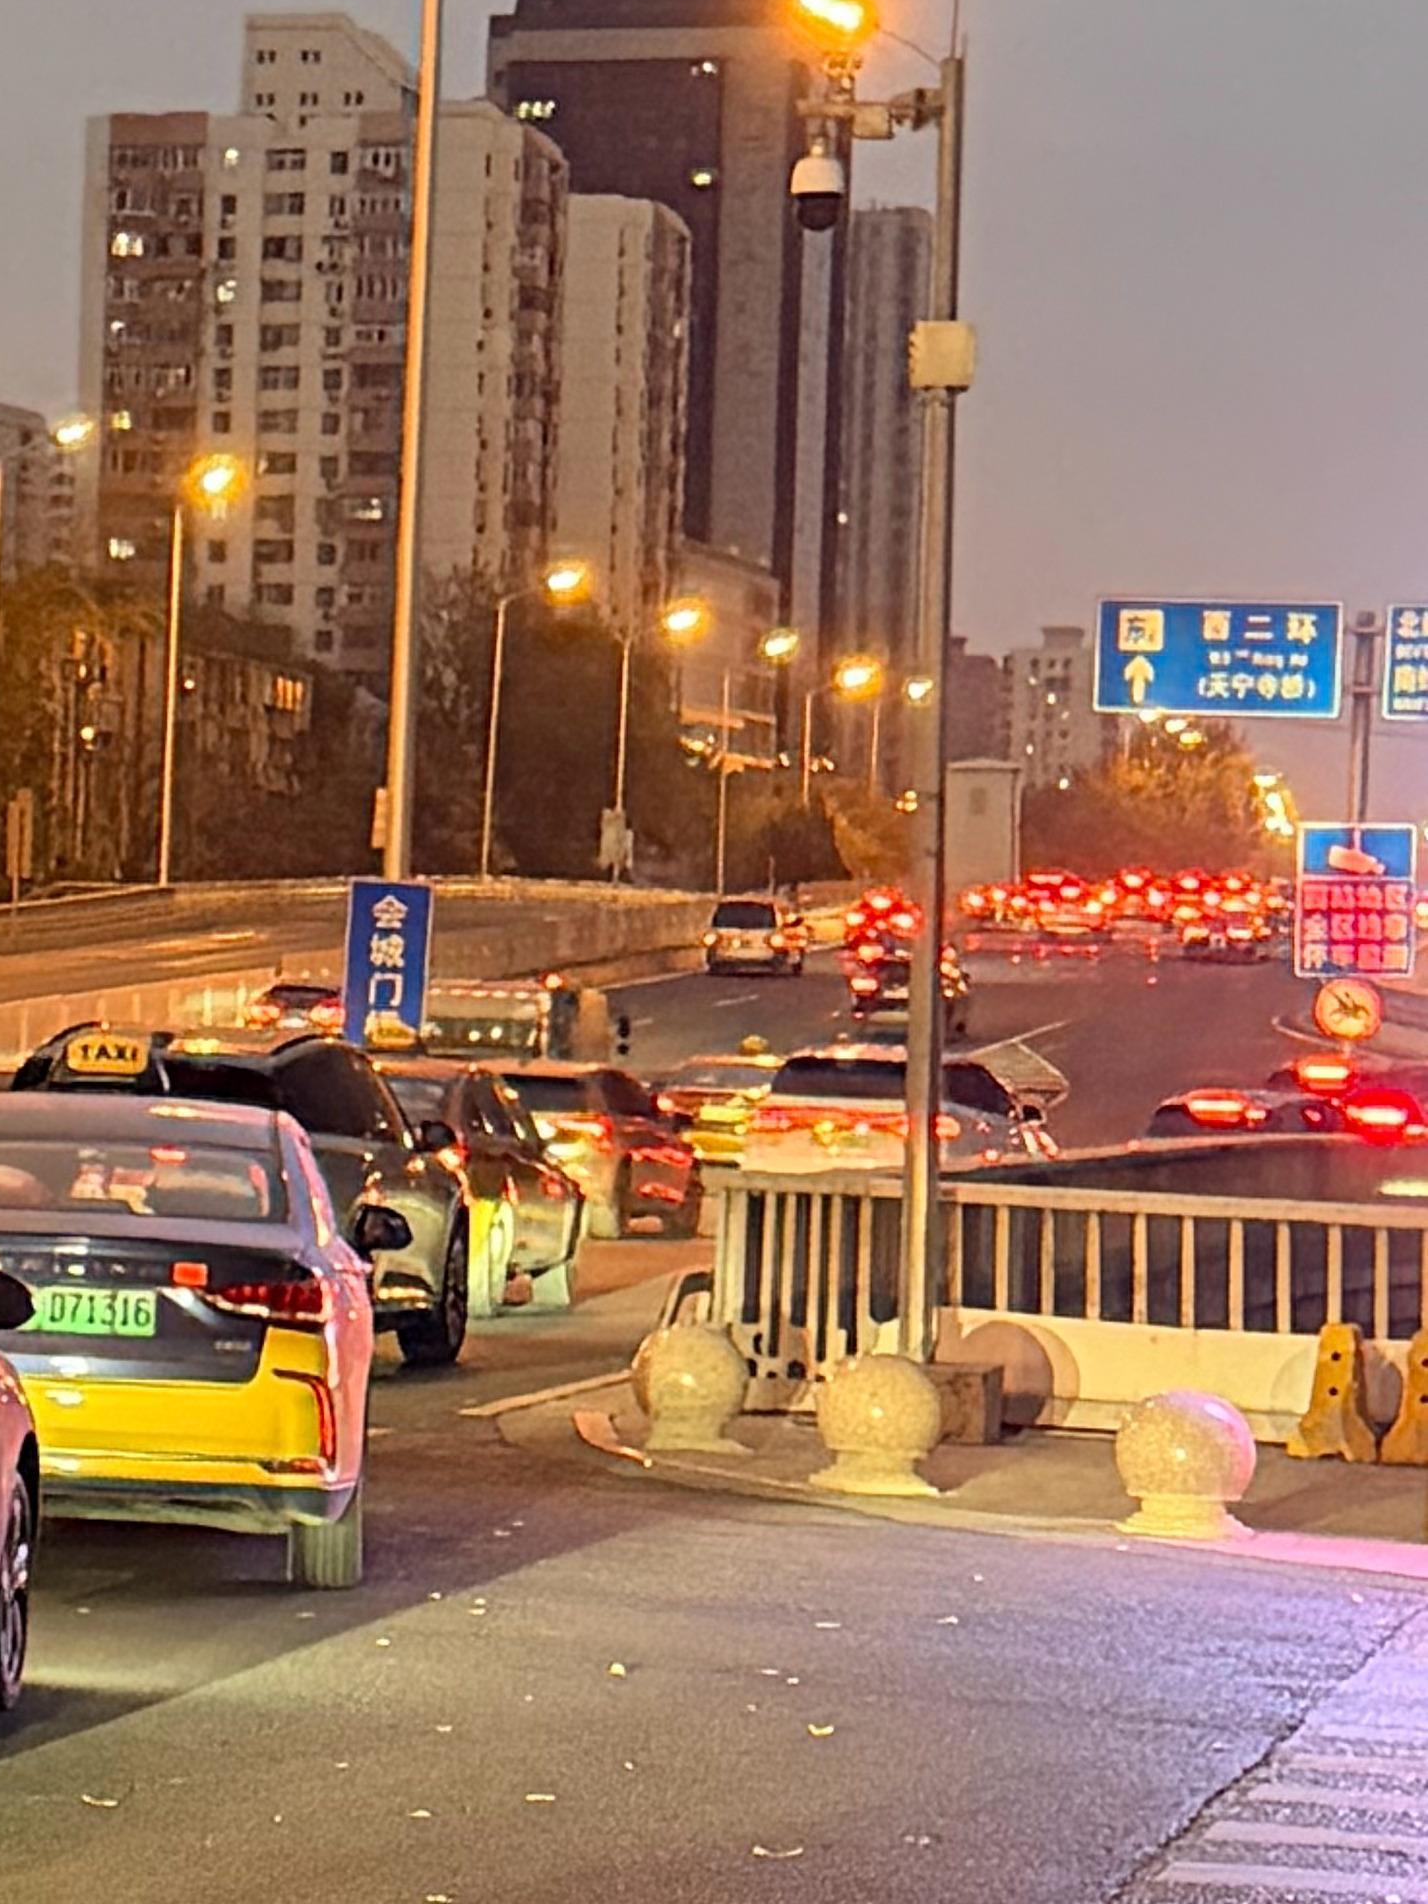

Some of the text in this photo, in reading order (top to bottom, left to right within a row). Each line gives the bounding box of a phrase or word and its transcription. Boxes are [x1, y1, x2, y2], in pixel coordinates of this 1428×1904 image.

[366, 894, 411, 1042] 会城门
[79, 1043, 139, 1063] TAXI
